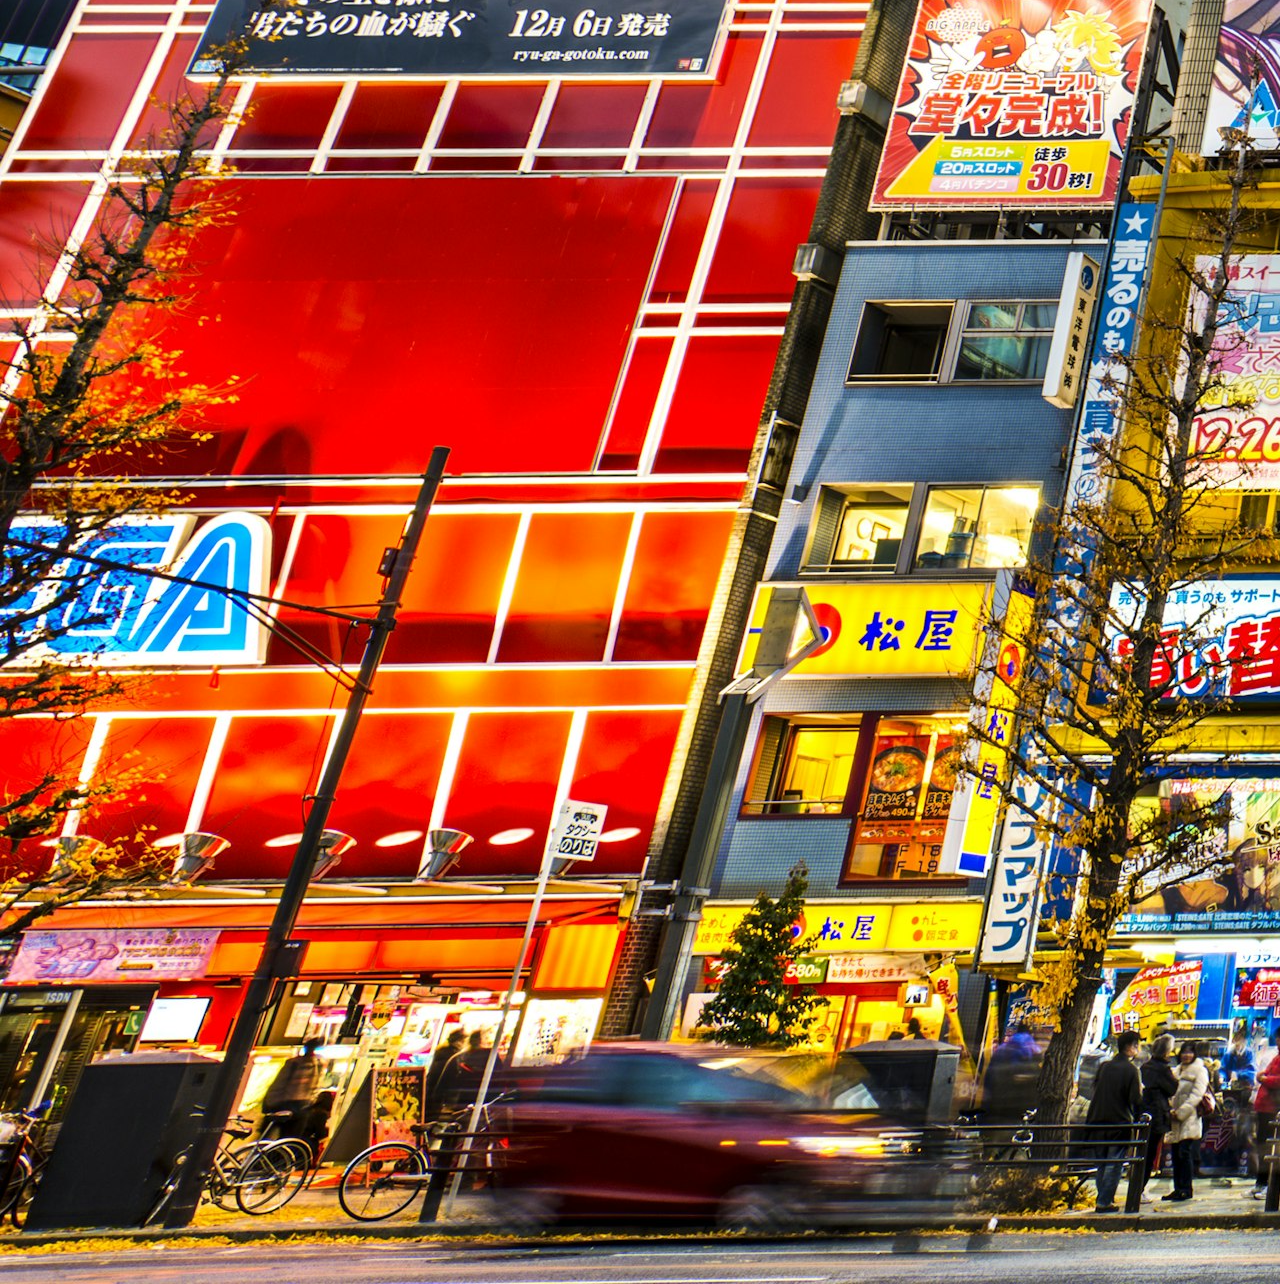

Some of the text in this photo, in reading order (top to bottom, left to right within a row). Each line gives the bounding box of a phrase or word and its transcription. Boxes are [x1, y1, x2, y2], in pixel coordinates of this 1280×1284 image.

[250, 9, 476, 38] 男たちの血が騒ぐ
[926, 20, 990, 33] BIG APPLE
[513, 48, 649, 63] ryu-ga-gotoku.com
[942, 73, 1096, 91] 全階リニューアル
[911, 92, 1104, 136] 堂々完成!
[950, 145, 1014, 159] 5円スロット
[1034, 147, 1067, 162] 徒歩
[940, 162, 1015, 175] 20円スロット
[940, 178, 1009, 190] 4円パチンコ
[1100, 237, 1147, 354] 売るのも
[1175, 588, 1227, 605] 買うのも
[858, 609, 959, 652] 松屋
[976, 707, 1009, 800] 松屋
[566, 823, 597, 837] タクシー
[559, 837, 596, 856] のりば
[991, 784, 1048, 953] ソフマップ
[821, 915, 875, 941] 松屋
[921, 916, 948, 926] カレー
[925, 930, 958, 942] 朝定食
[786, 962, 821, 978] 580円
[45, 991, 72, 1003] ISDN
